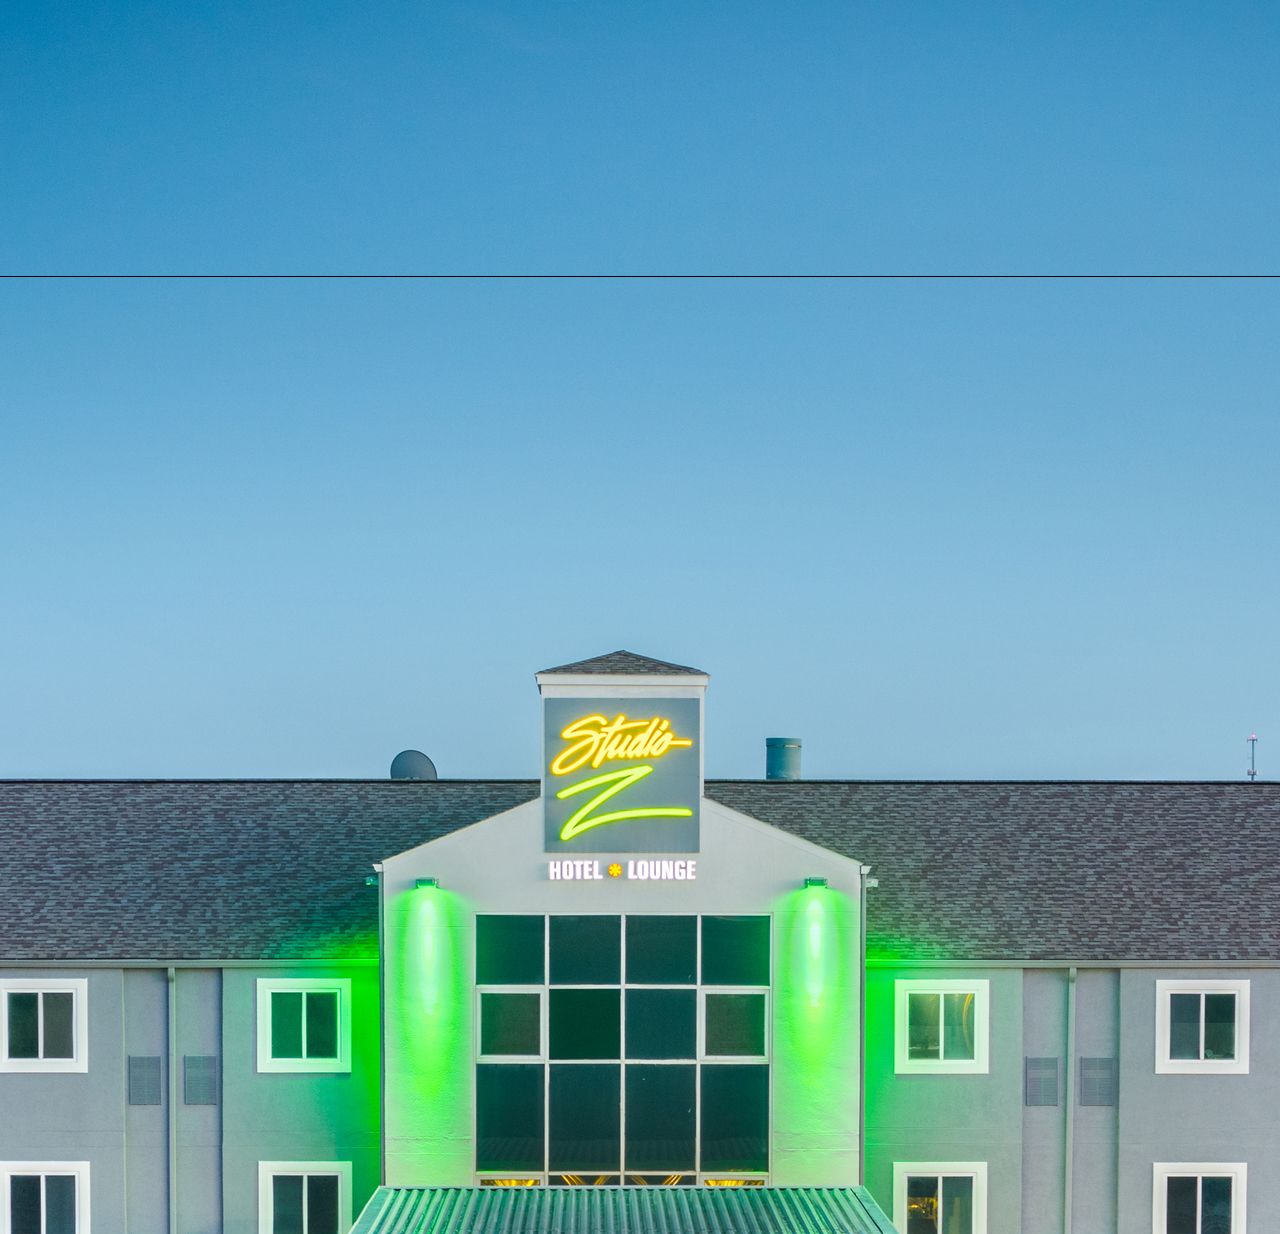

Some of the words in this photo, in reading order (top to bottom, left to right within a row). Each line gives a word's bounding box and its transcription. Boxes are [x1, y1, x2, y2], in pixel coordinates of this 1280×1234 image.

[550, 713, 693, 776] Studio
[556, 765, 693, 841] Z
[549, 860, 603, 880] HOTEL
[627, 860, 697, 880] LOUNGE
